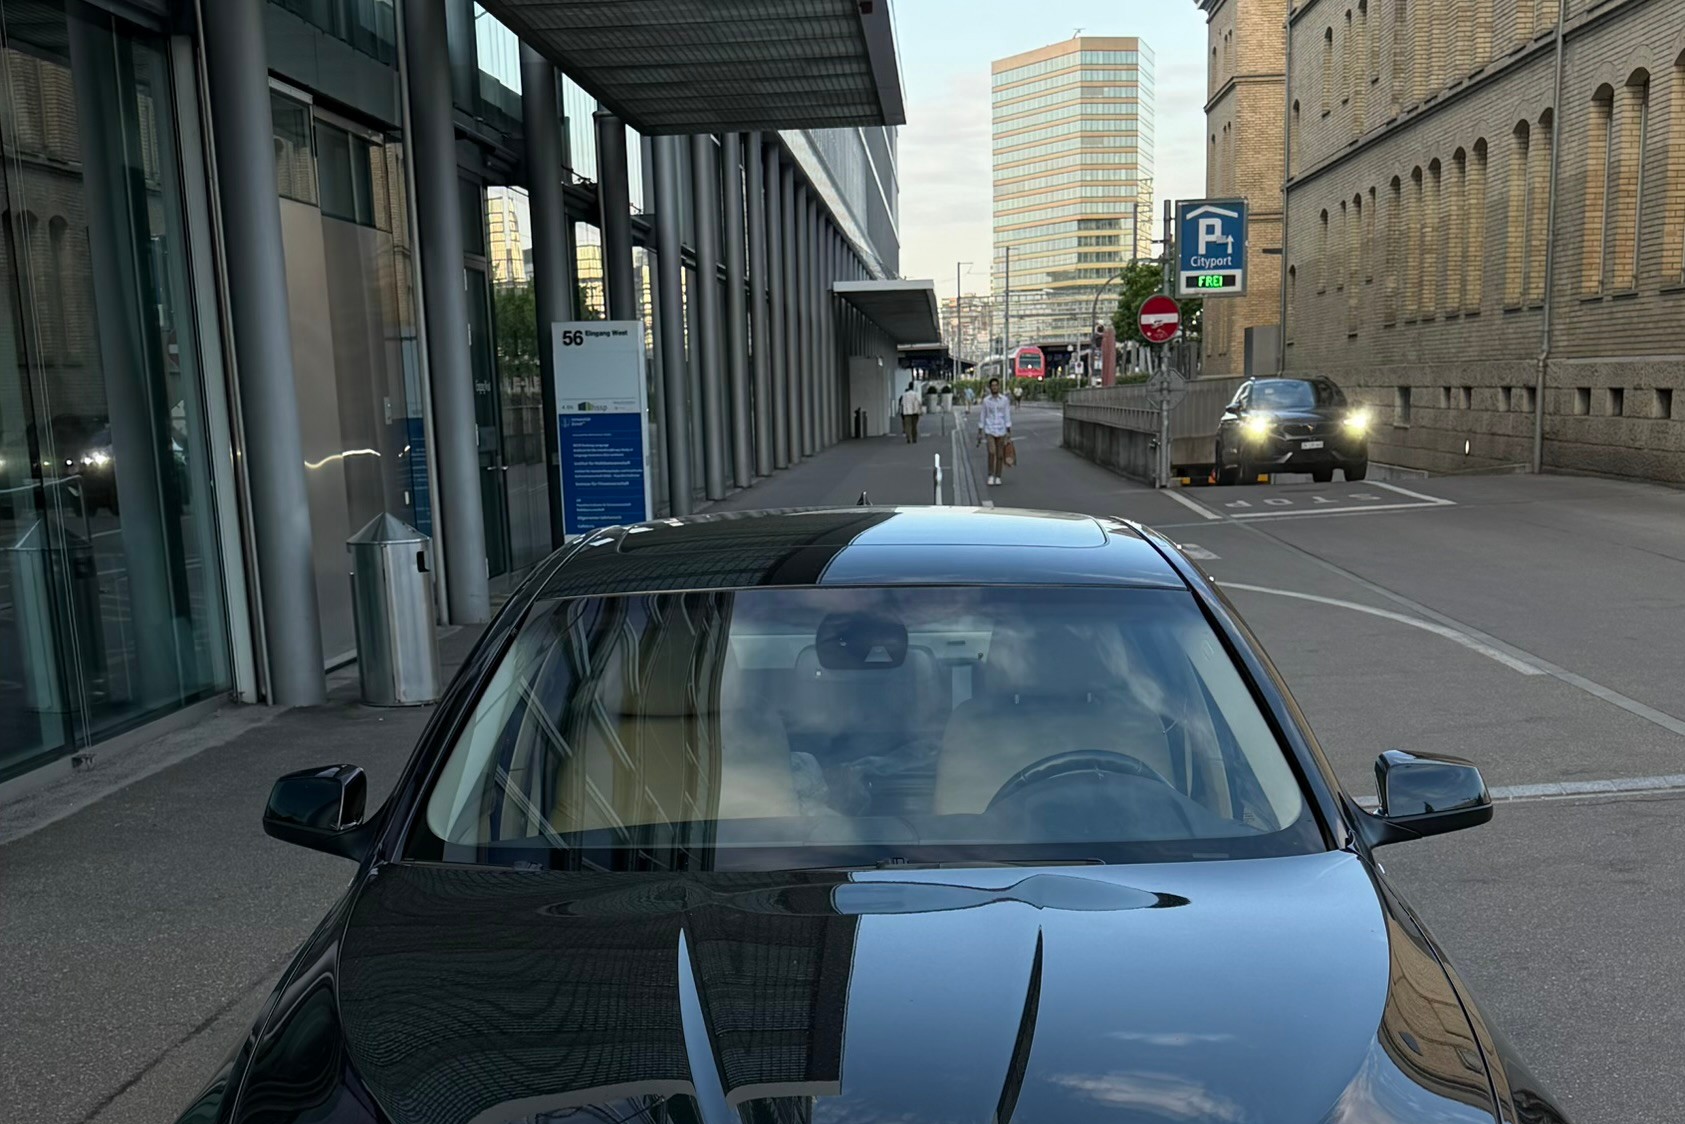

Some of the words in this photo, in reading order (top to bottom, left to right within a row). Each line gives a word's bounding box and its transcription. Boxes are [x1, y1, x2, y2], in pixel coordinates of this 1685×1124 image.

[1198, 217, 1222, 255] P
[1190, 256, 1232, 269] Cityport
[1198, 275, 1223, 287] FREI
[562, 330, 584, 346] 56
[585, 330, 611, 338] Eingang
[1224, 493, 1382, 508] STOP
